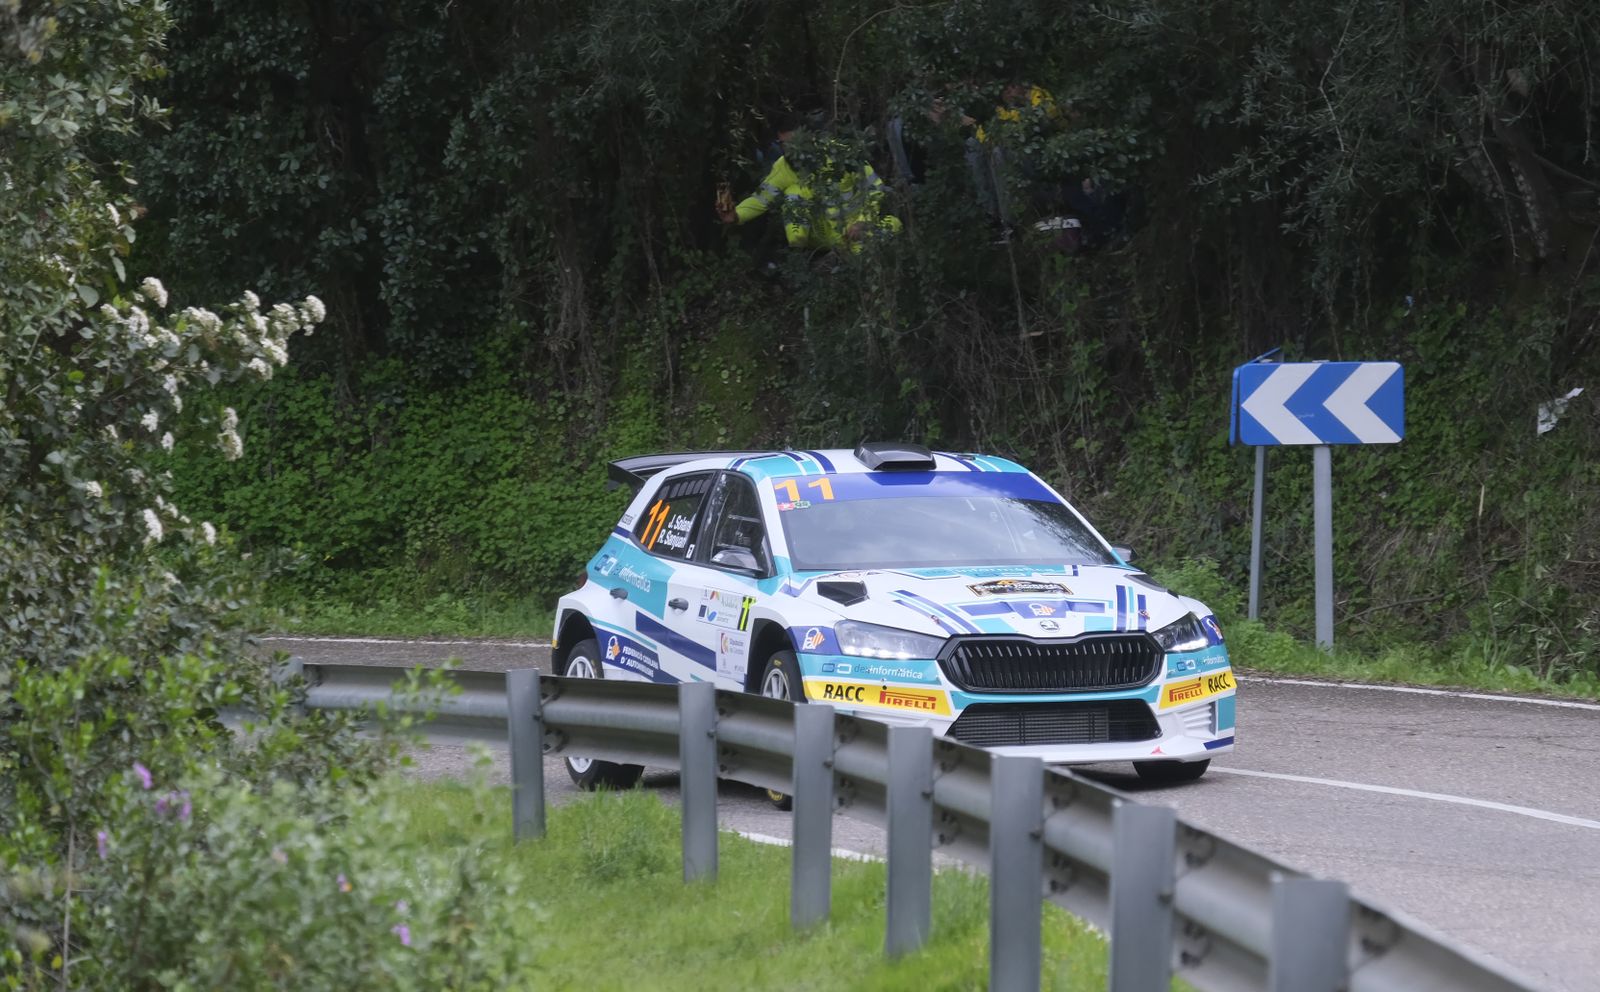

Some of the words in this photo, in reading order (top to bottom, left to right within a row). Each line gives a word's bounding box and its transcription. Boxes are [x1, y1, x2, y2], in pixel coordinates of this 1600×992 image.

[774, 477, 835, 502] 11
[641, 499, 671, 551] 11
[823, 684, 865, 702] RACC
[879, 690, 937, 711] PIRELLI
[1169, 683, 1203, 703] PIRELLI
[1208, 673, 1231, 694] RACC
